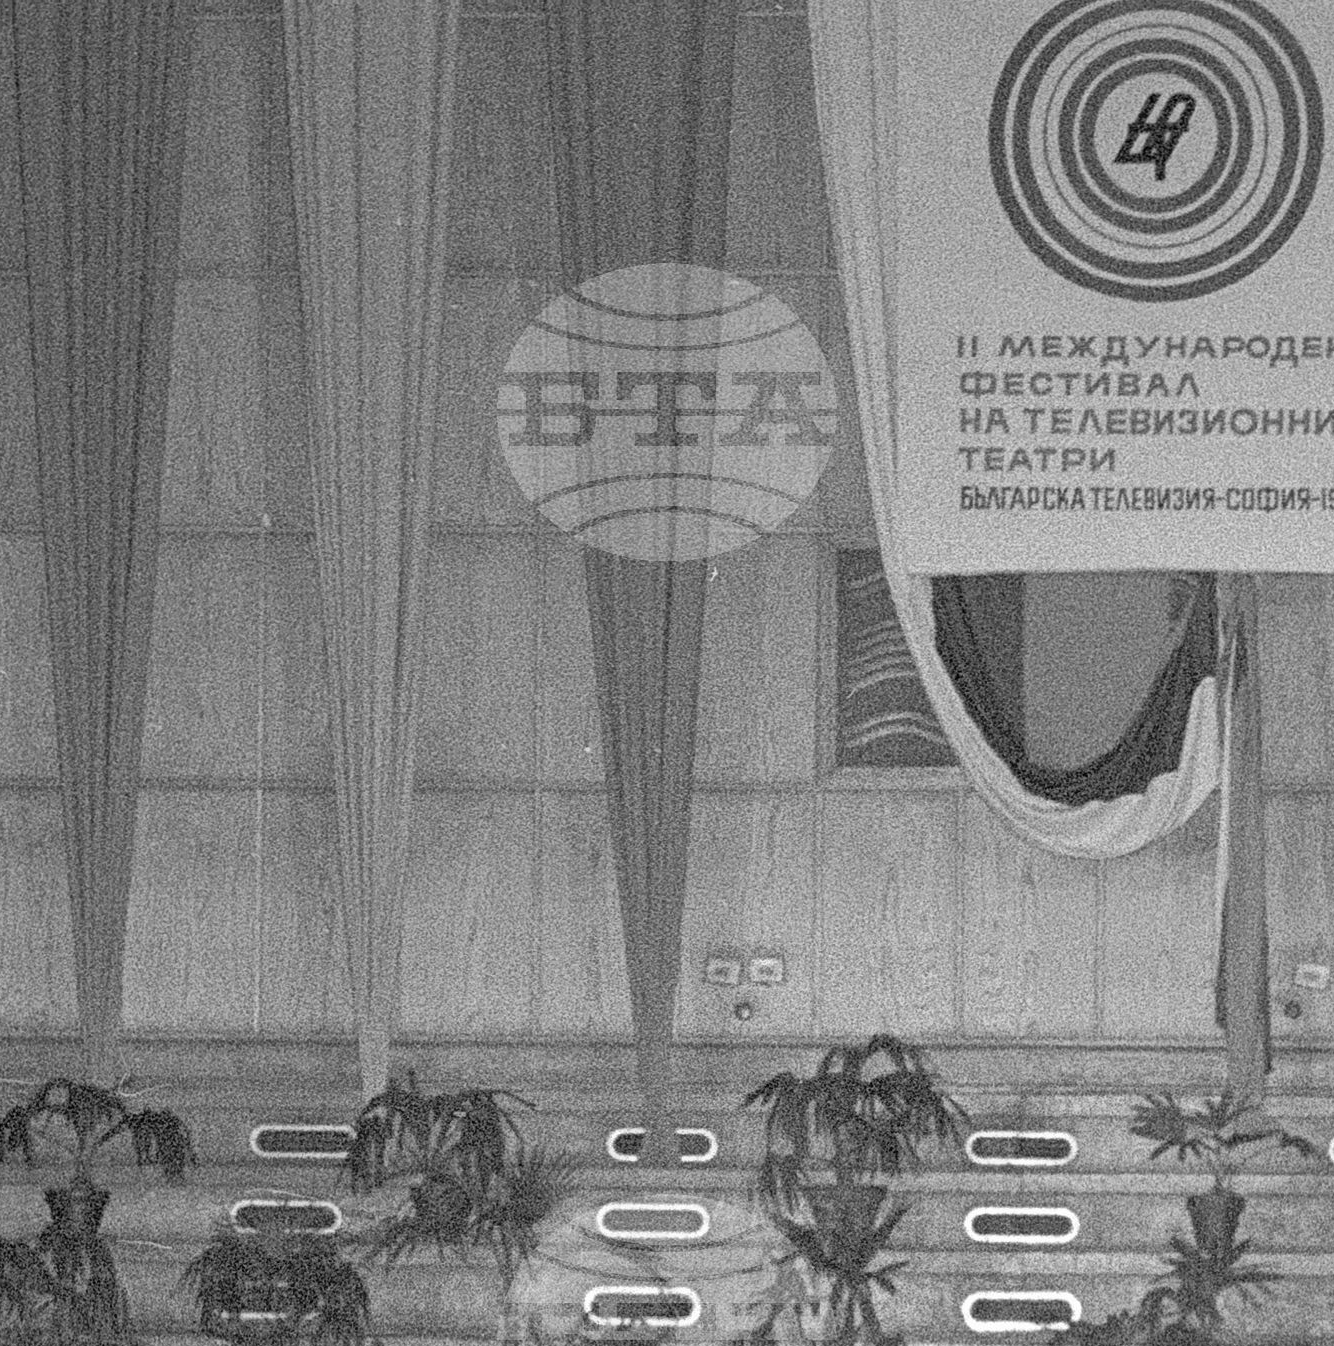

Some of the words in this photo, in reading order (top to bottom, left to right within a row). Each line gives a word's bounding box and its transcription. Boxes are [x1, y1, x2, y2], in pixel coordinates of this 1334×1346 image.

[956, 335, 981, 359] II
[958, 369, 1202, 398] ФЕСТИВАЛ
[958, 406, 1011, 436] НА
[958, 446, 1117, 473] ТЕАТРИ
